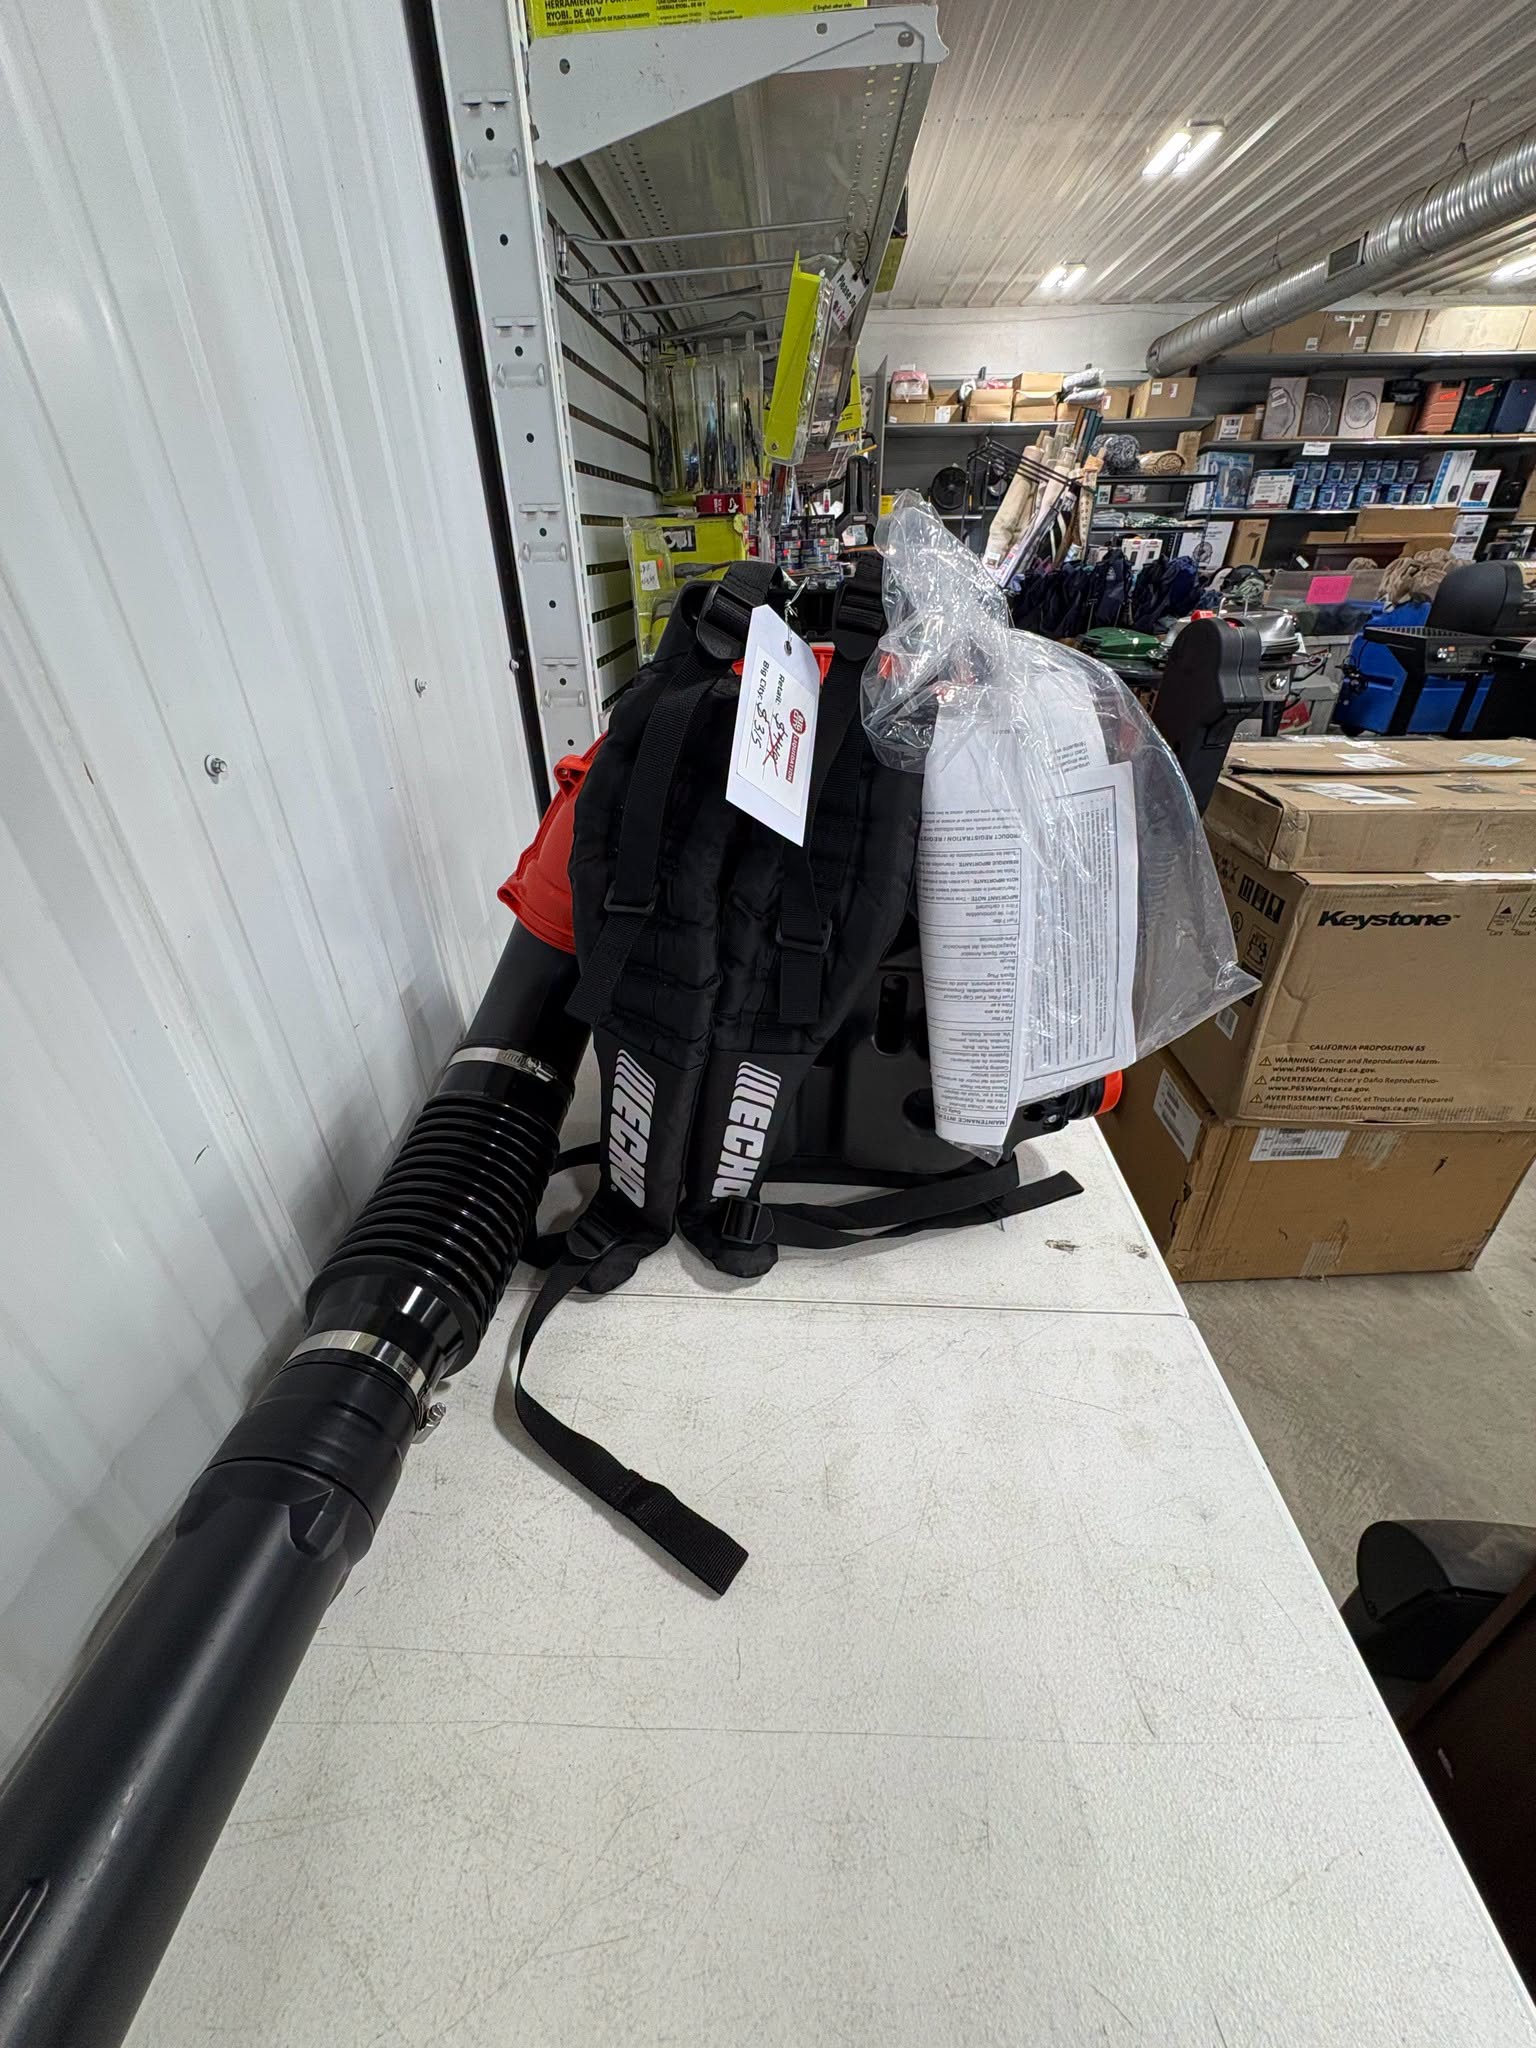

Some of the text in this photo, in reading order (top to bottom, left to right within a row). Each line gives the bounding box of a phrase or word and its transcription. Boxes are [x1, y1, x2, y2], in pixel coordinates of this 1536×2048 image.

[546, 7, 602, 21] RYOBI DE 40 V
[837, 274, 852, 300] Please
[761, 661, 769, 676] Big
[757, 678, 767, 700] City:
[775, 674, 785, 705] Retail:
[787, 735, 799, 781] LIQUIDATION
[1317, 910, 1452, 930] Keystone
[1268, 1085, 1370, 1093] www.P65Warnings.ca.gov.
[1418, 1096, 1453, 1104] l'appareil
[958, 1117, 1005, 1125] MAINTENANCE
[609, 1087, 651, 1208] ECHO
[711, 1099, 772, 1198] ECHO
